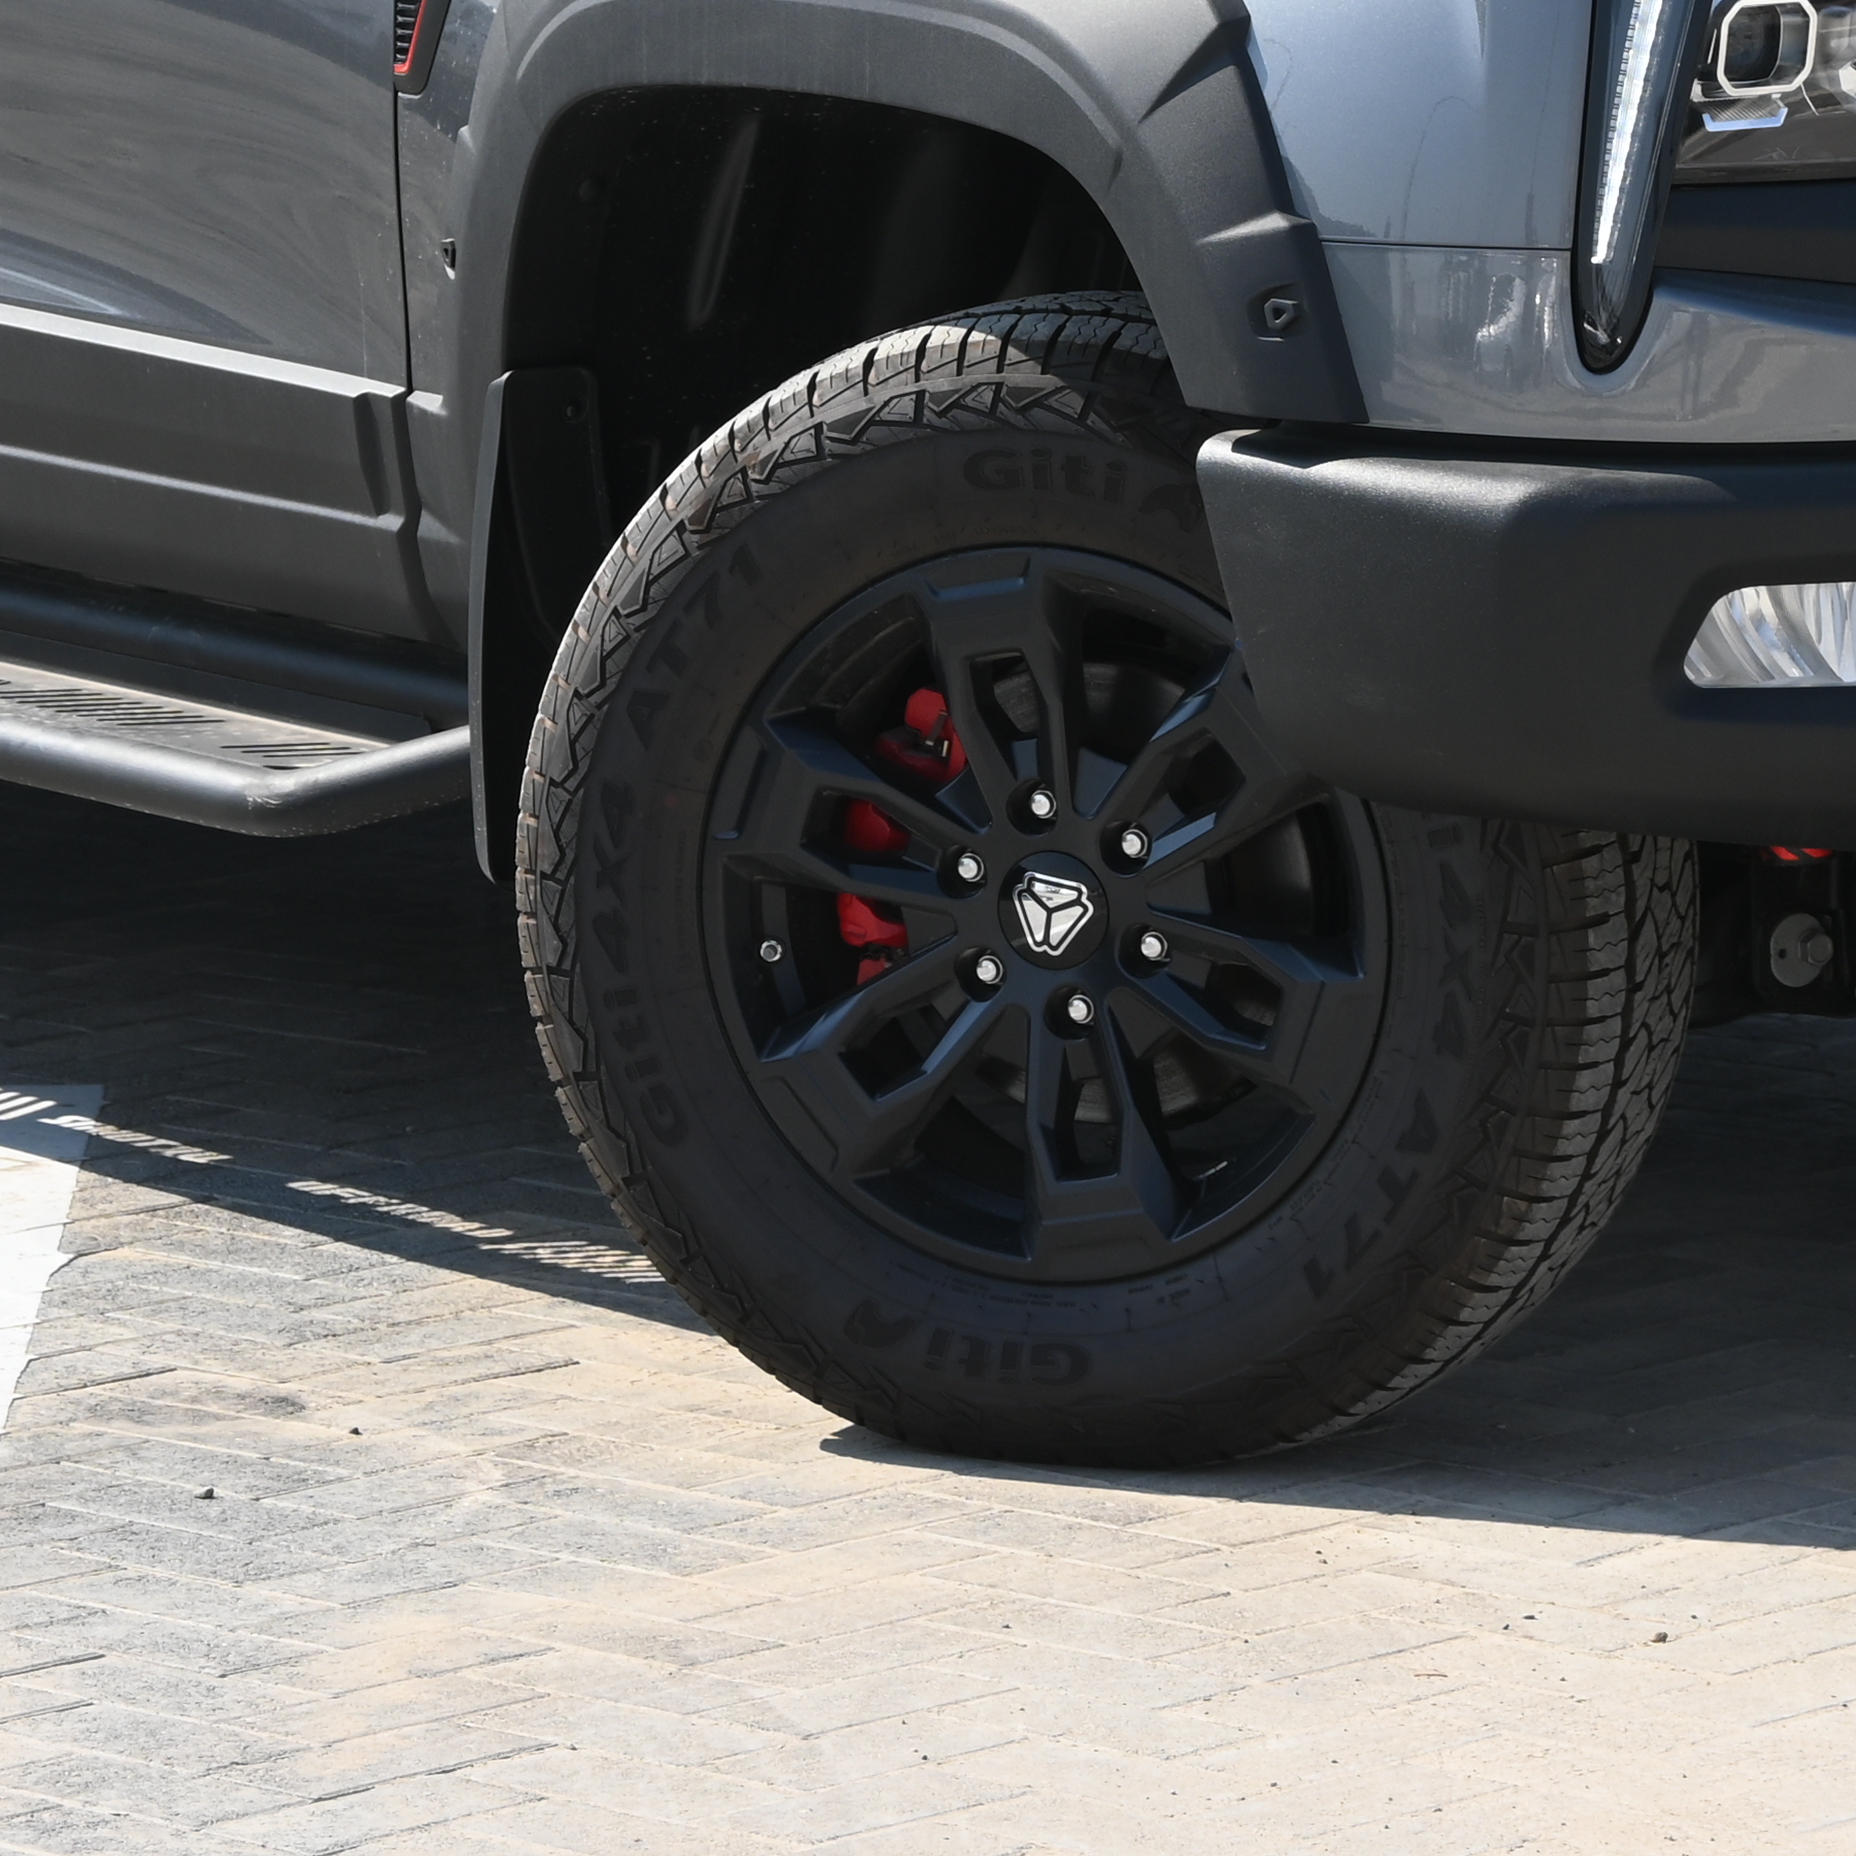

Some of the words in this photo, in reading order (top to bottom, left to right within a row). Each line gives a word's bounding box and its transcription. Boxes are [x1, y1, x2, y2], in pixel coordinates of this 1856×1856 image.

[961, 446, 1128, 506] Giti
[625, 538, 765, 752] AT71
[602, 985, 689, 1149] Giti
[924, 1326, 1092, 1389] Giti
